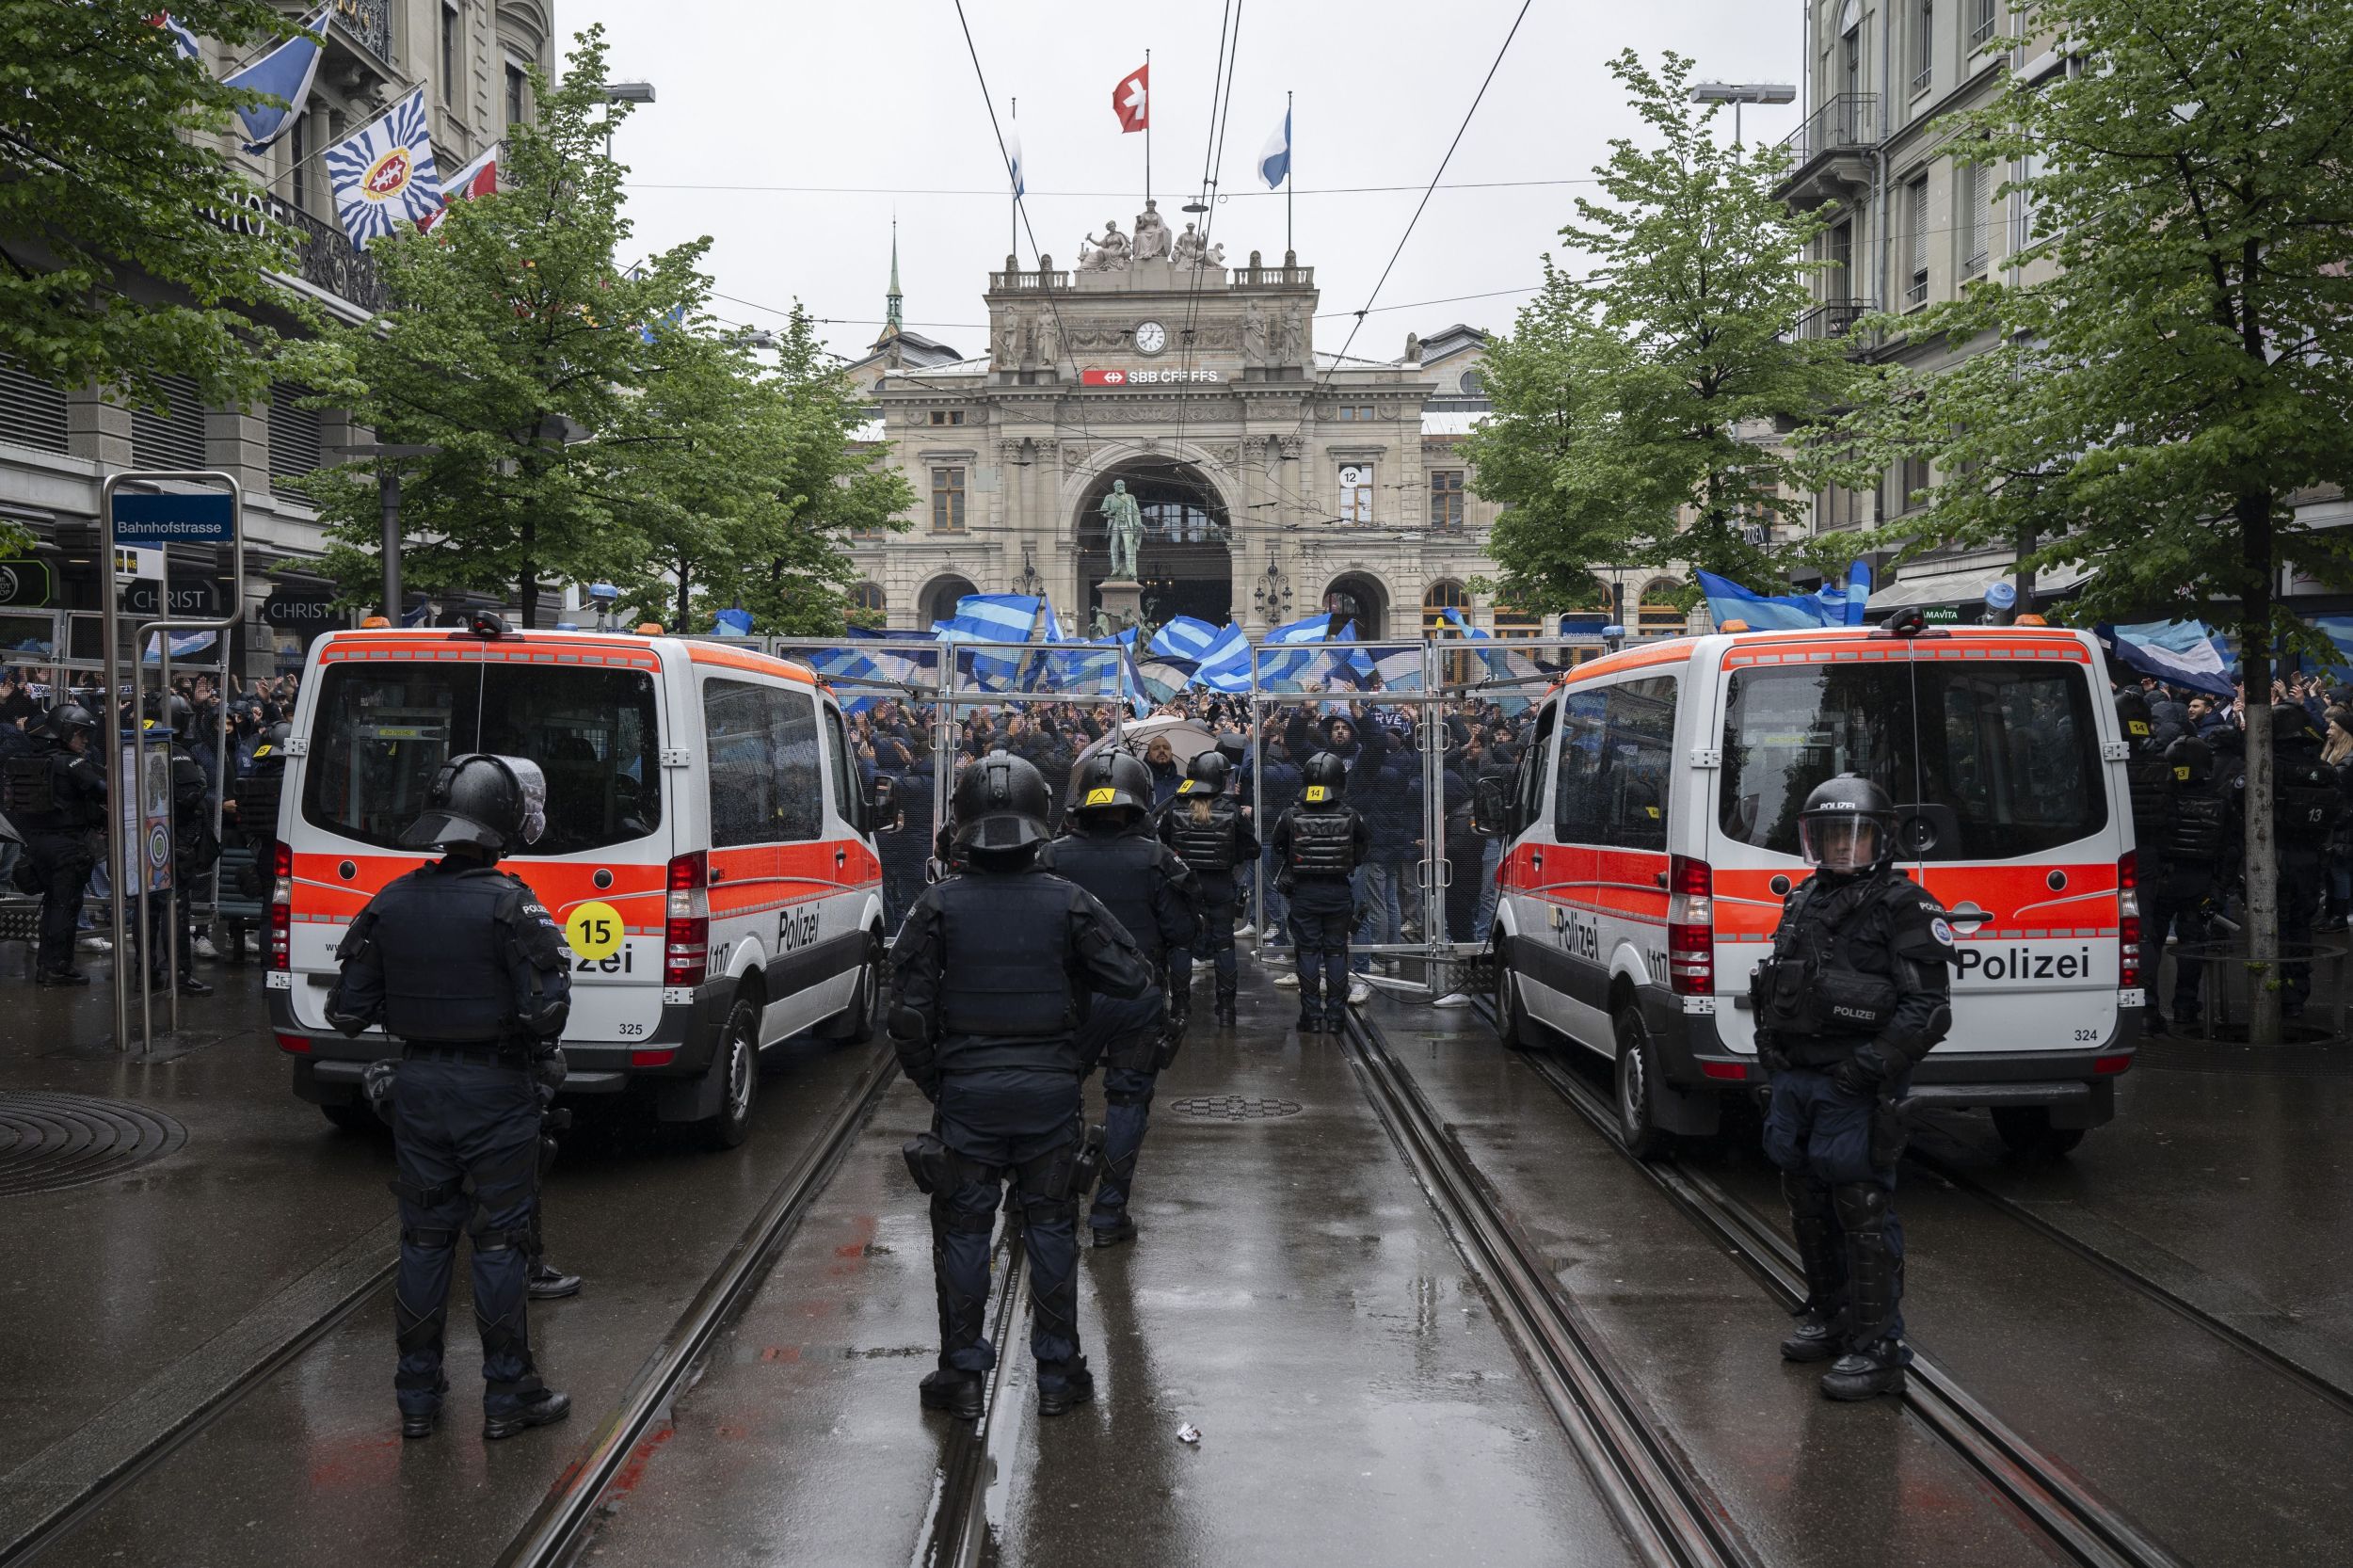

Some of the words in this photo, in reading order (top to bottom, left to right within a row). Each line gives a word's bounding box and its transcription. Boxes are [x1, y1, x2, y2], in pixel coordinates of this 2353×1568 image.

[1129, 371, 1158, 383] SBB
[1160, 371, 1188, 383] CFF
[1191, 370, 1218, 382] FFS
[1344, 472, 1356, 483] 12
[118, 521, 222, 534] Bahnhofstrasse
[1743, 524, 1765, 546] ARREN
[134, 590, 205, 608] CHRIST
[270, 602, 329, 618] CHRIST
[1311, 789, 1320, 797] 14
[1820, 801, 1855, 809] POLIZEI
[2308, 808, 2323, 822] 13
[580, 920, 611, 944] 15
[777, 902, 820, 954] Polizei
[1558, 908, 1599, 961] Polizei
[714, 942, 729, 973] 117
[1957, 946, 2089, 980] Polizei
[1651, 950, 1668, 983] 117
[1833, 1005, 1876, 1021] POLIZEI
[618, 1023, 643, 1035] 325
[2074, 1030, 2098, 1041] 324
